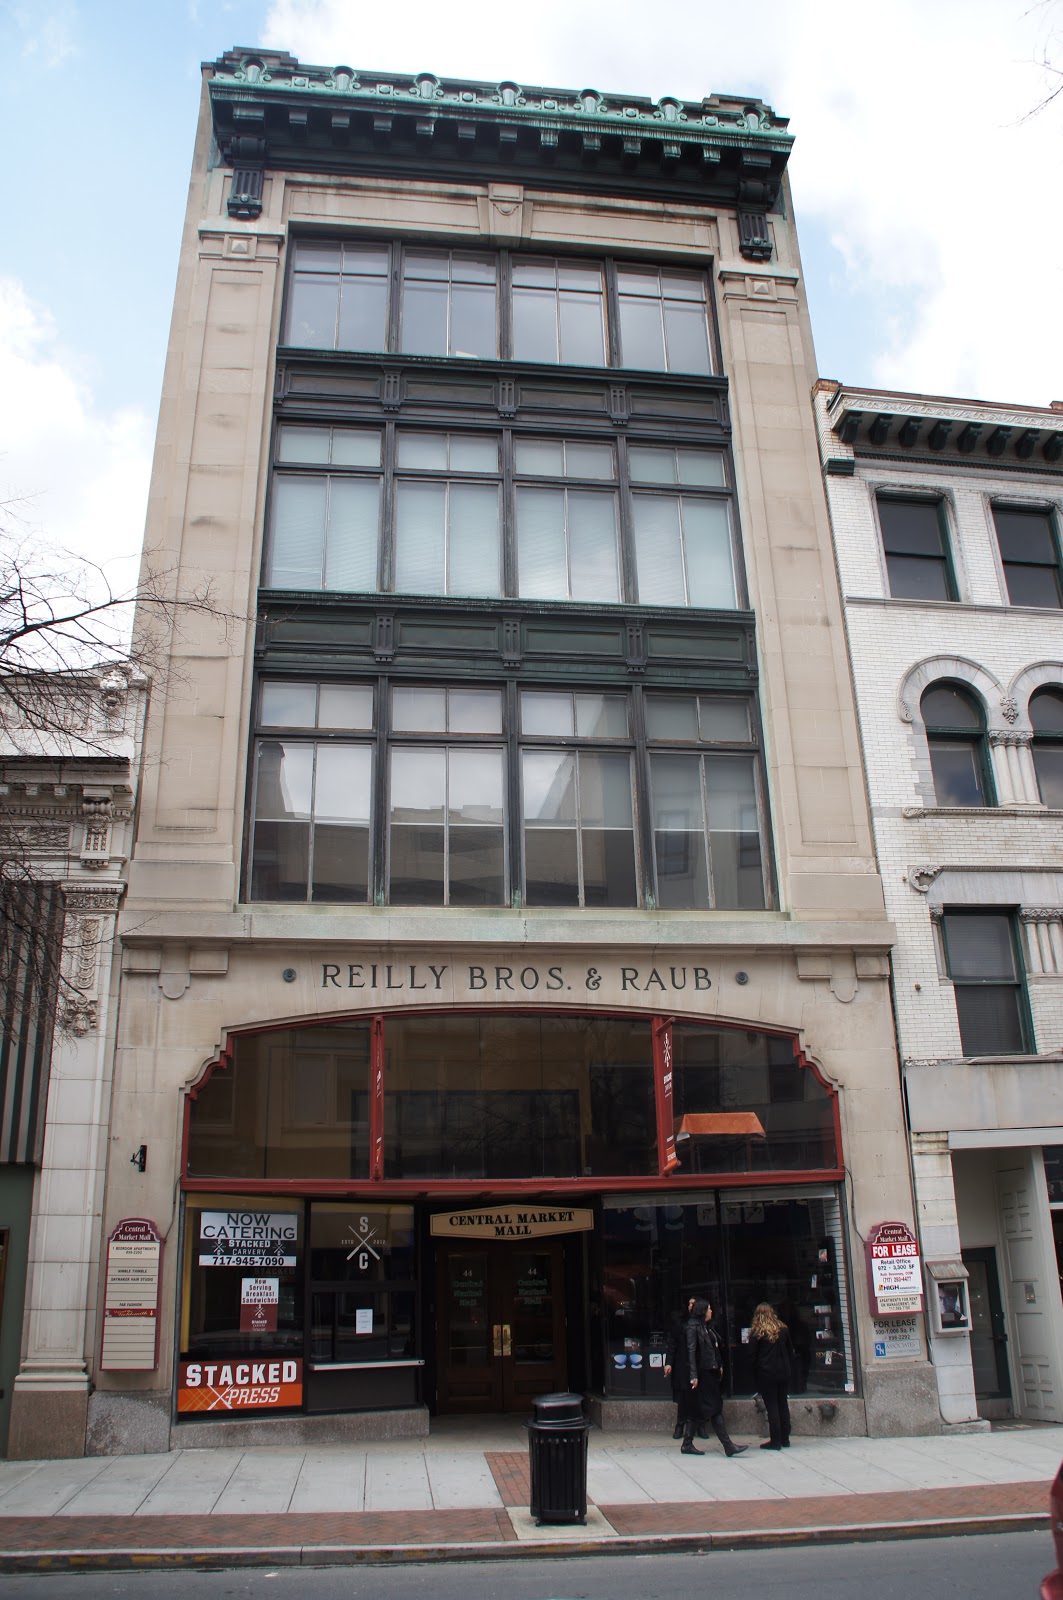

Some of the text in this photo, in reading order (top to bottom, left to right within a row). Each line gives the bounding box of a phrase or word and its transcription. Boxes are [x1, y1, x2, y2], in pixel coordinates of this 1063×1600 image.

[321, 964, 712, 992] REILLY BROS. & RAUB
[227, 1214, 271, 1226] NOW
[360, 1216, 368, 1232] S
[450, 1212, 574, 1226] CENTRAL MARKET
[203, 1226, 295, 1240] CATERING
[495, 1226, 532, 1237] MALL
[228, 1240, 271, 1248] STACKED
[872, 1244, 917, 1258] FOR LEASE
[212, 1256, 284, 1266] 717-945-7090
[359, 1252, 368, 1270] C
[892, 1319, 916, 1327] LEASE
[186, 1360, 297, 1387] STACKED
